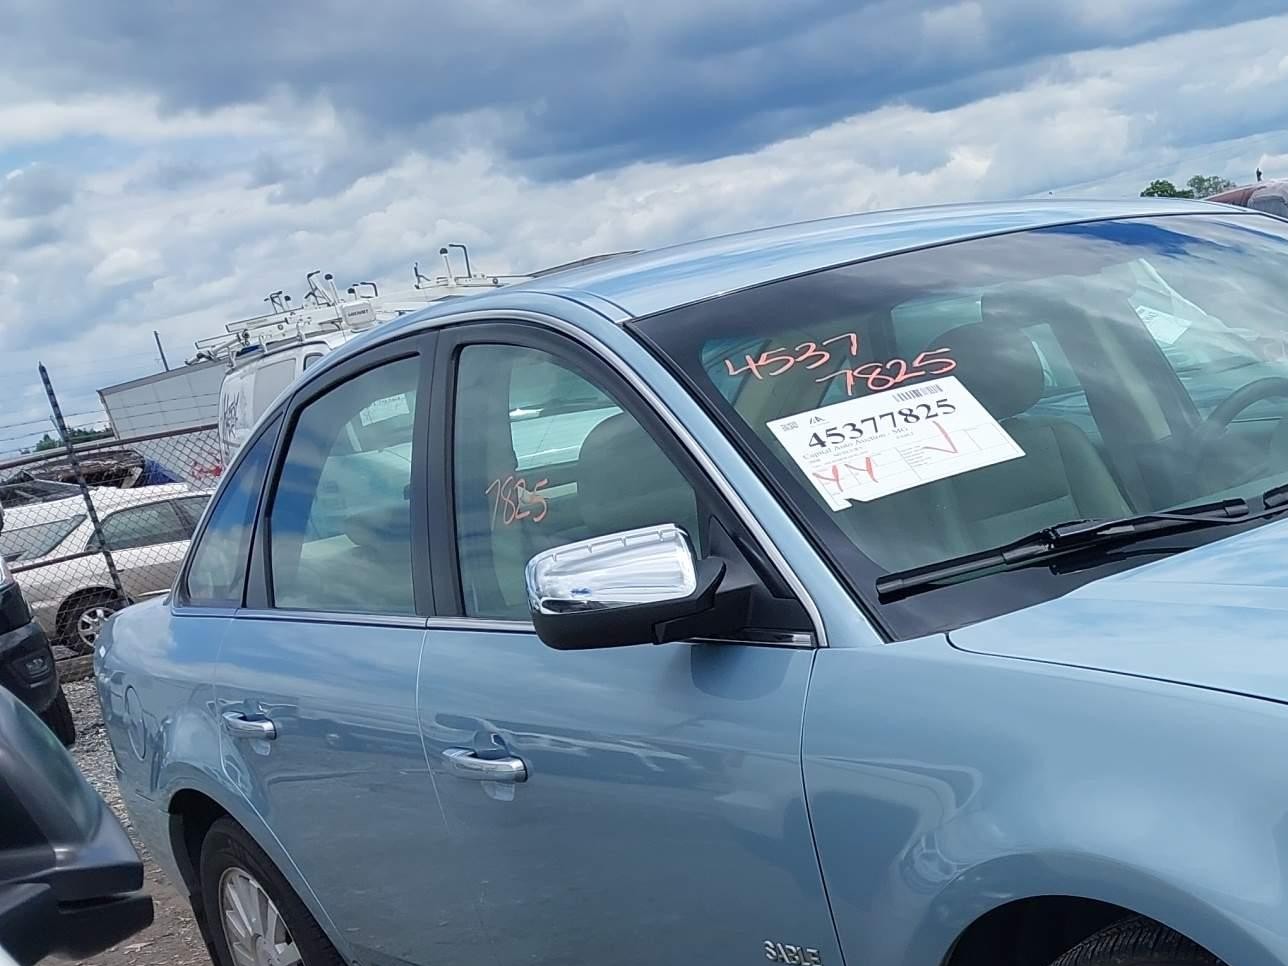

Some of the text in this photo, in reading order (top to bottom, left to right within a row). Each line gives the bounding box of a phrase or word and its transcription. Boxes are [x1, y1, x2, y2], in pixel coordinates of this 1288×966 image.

[724, 333, 858, 380] 4537
[815, 348, 957, 396] 7825
[808, 398, 956, 448] 45377825
